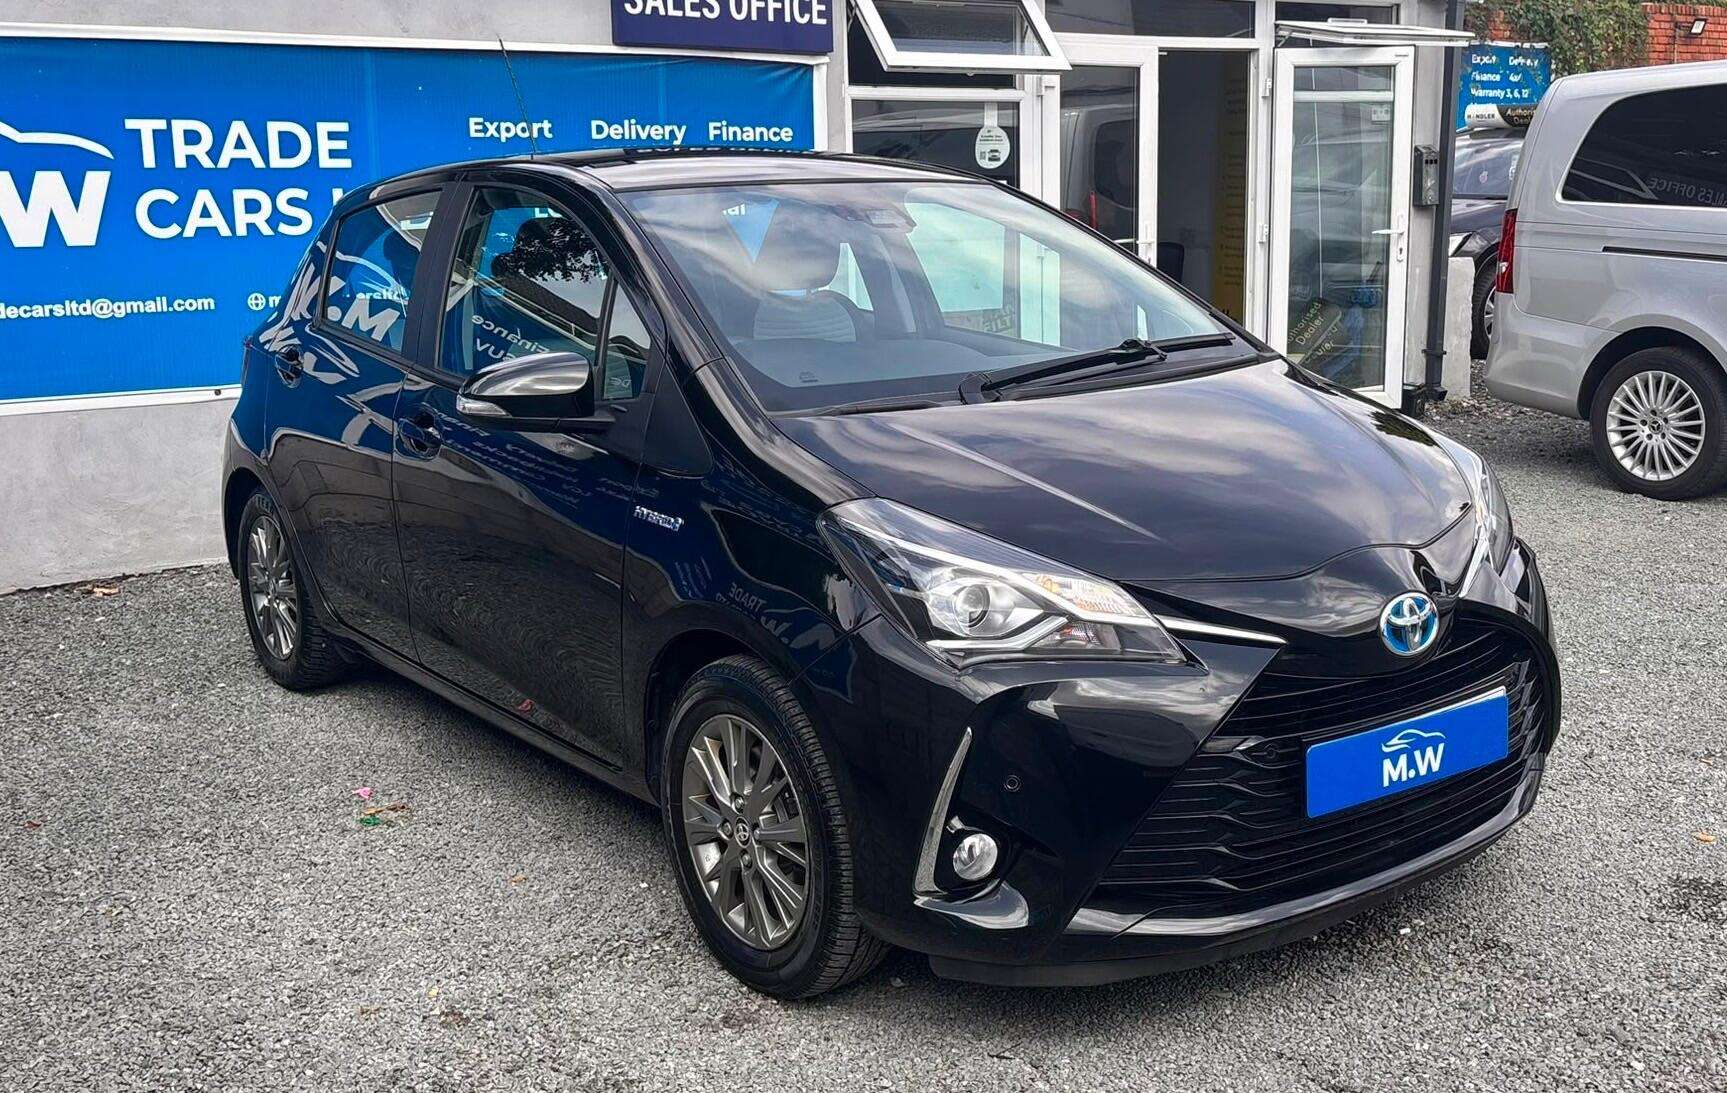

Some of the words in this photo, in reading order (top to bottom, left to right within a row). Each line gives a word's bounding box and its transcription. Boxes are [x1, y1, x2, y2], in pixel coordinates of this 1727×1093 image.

[729, 0, 827, 25] OFFICE
[1470, 88, 1505, 99] Warranty
[468, 117, 553, 140] Export
[591, 119, 687, 146] Delivery
[708, 121, 794, 142] Finance
[124, 118, 353, 170] TRADE
[135, 188, 313, 239] CARS
[1382, 742, 1445, 788] M.W
